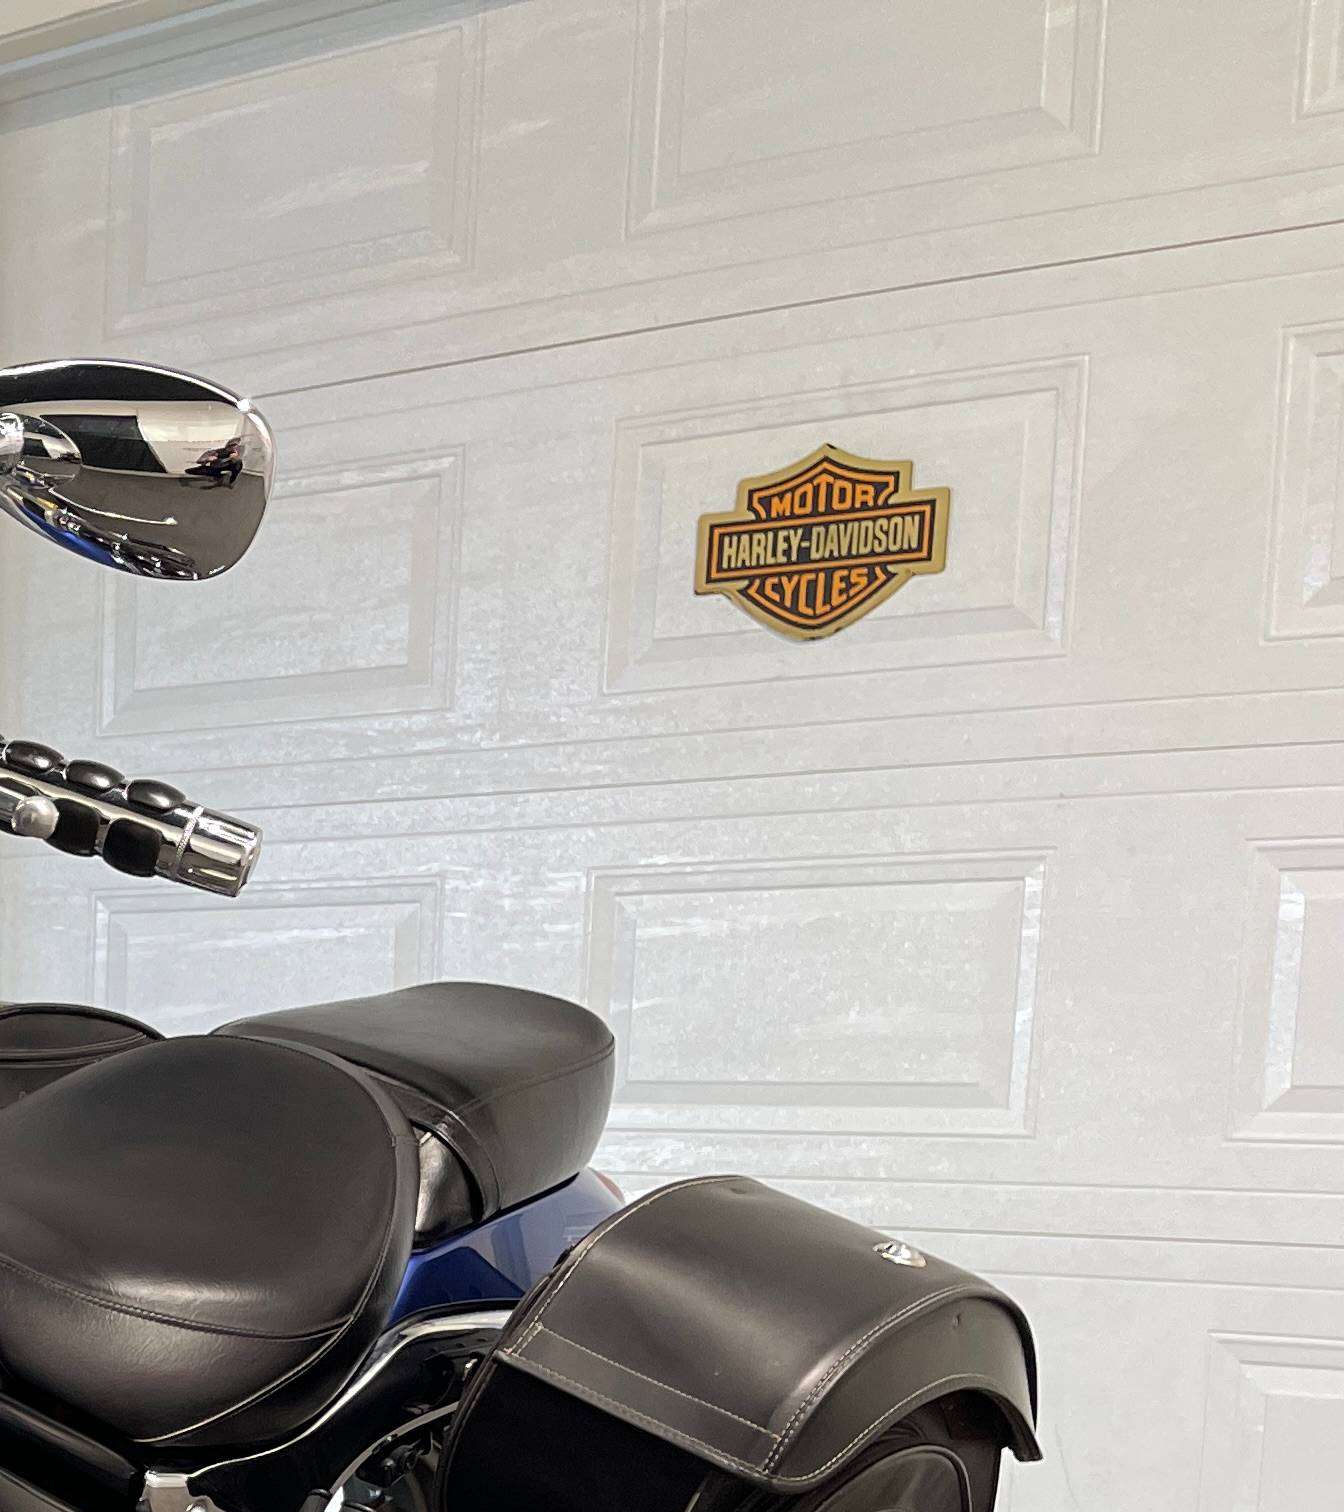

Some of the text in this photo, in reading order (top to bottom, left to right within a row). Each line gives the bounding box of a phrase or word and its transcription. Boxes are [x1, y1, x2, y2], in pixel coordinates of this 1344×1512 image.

[770, 474, 875, 518] MOTOR
[721, 514, 921, 570] HARLEY-DAVIDSON
[764, 566, 869, 616] CYCLES
